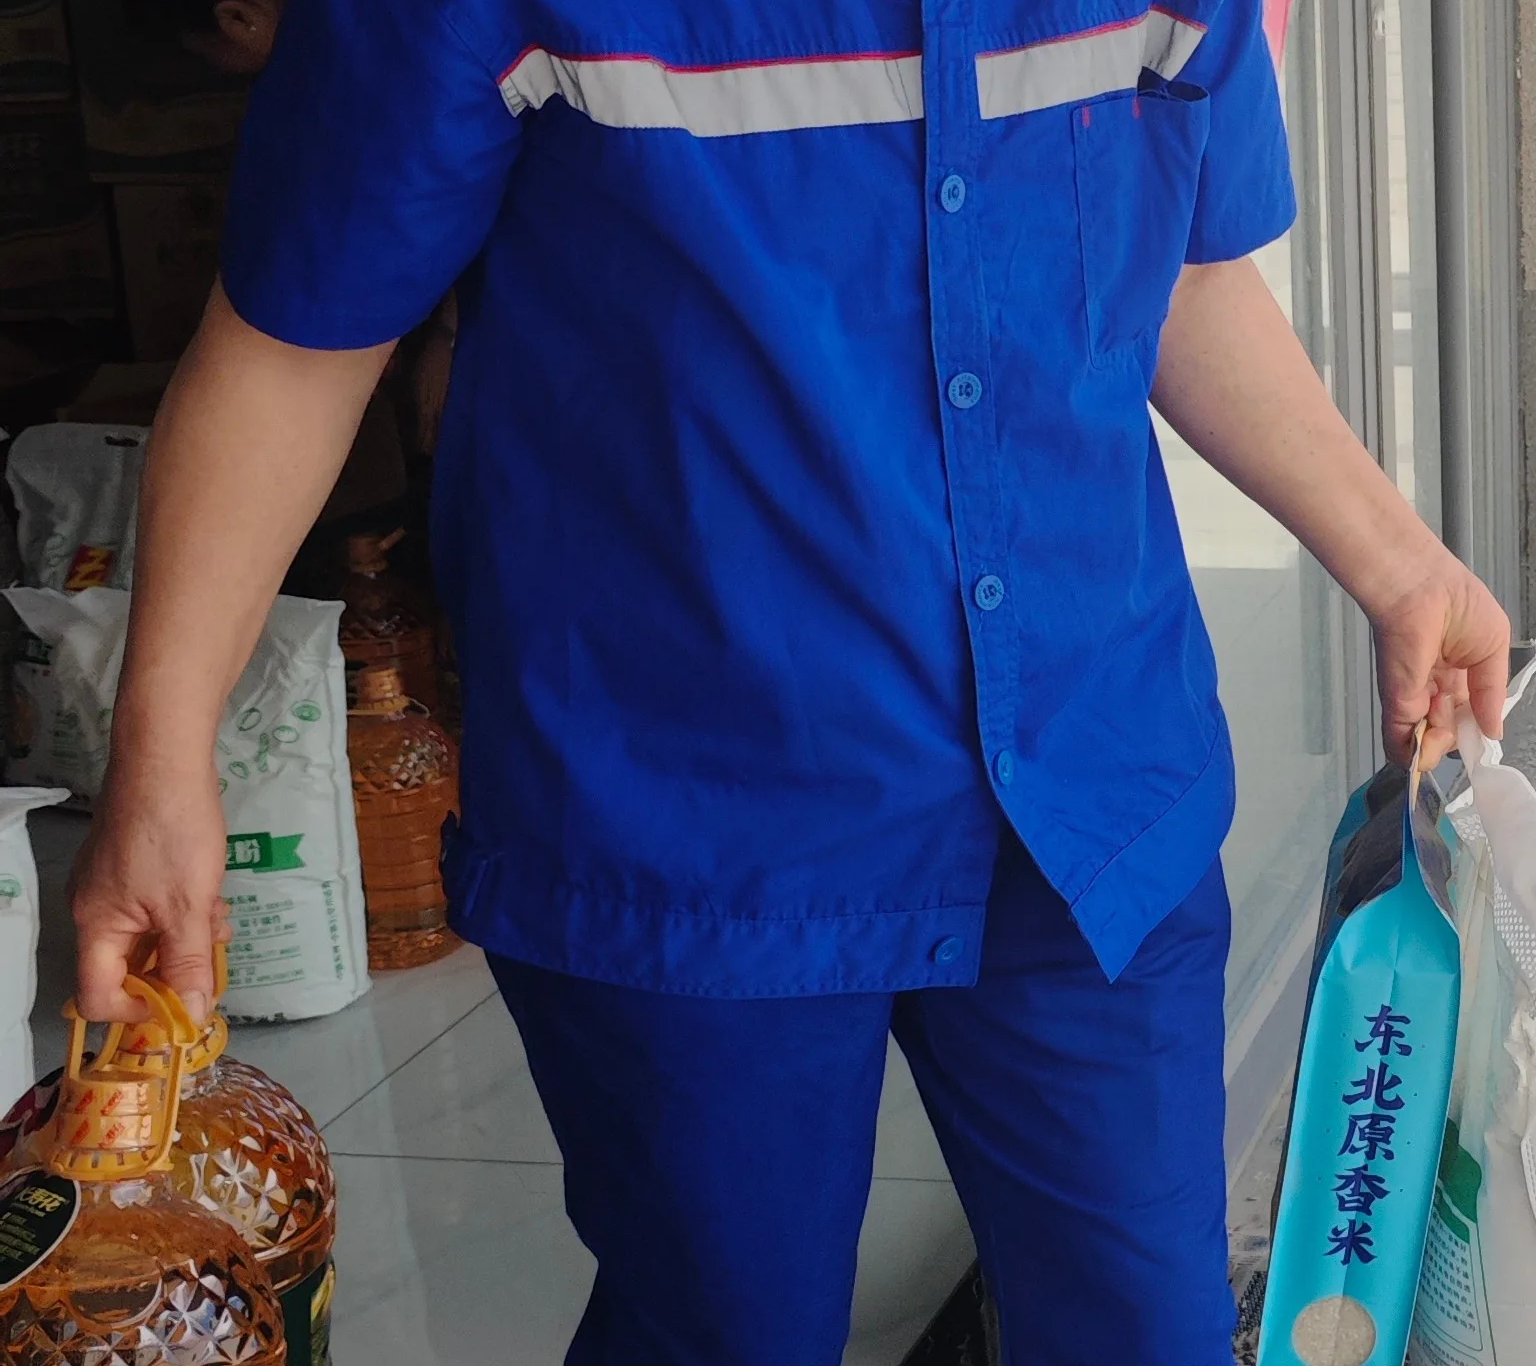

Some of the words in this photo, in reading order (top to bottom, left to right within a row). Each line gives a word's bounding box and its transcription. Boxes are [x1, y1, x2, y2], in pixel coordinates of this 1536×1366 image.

[1321, 1003, 1412, 1266] 东北原香米
